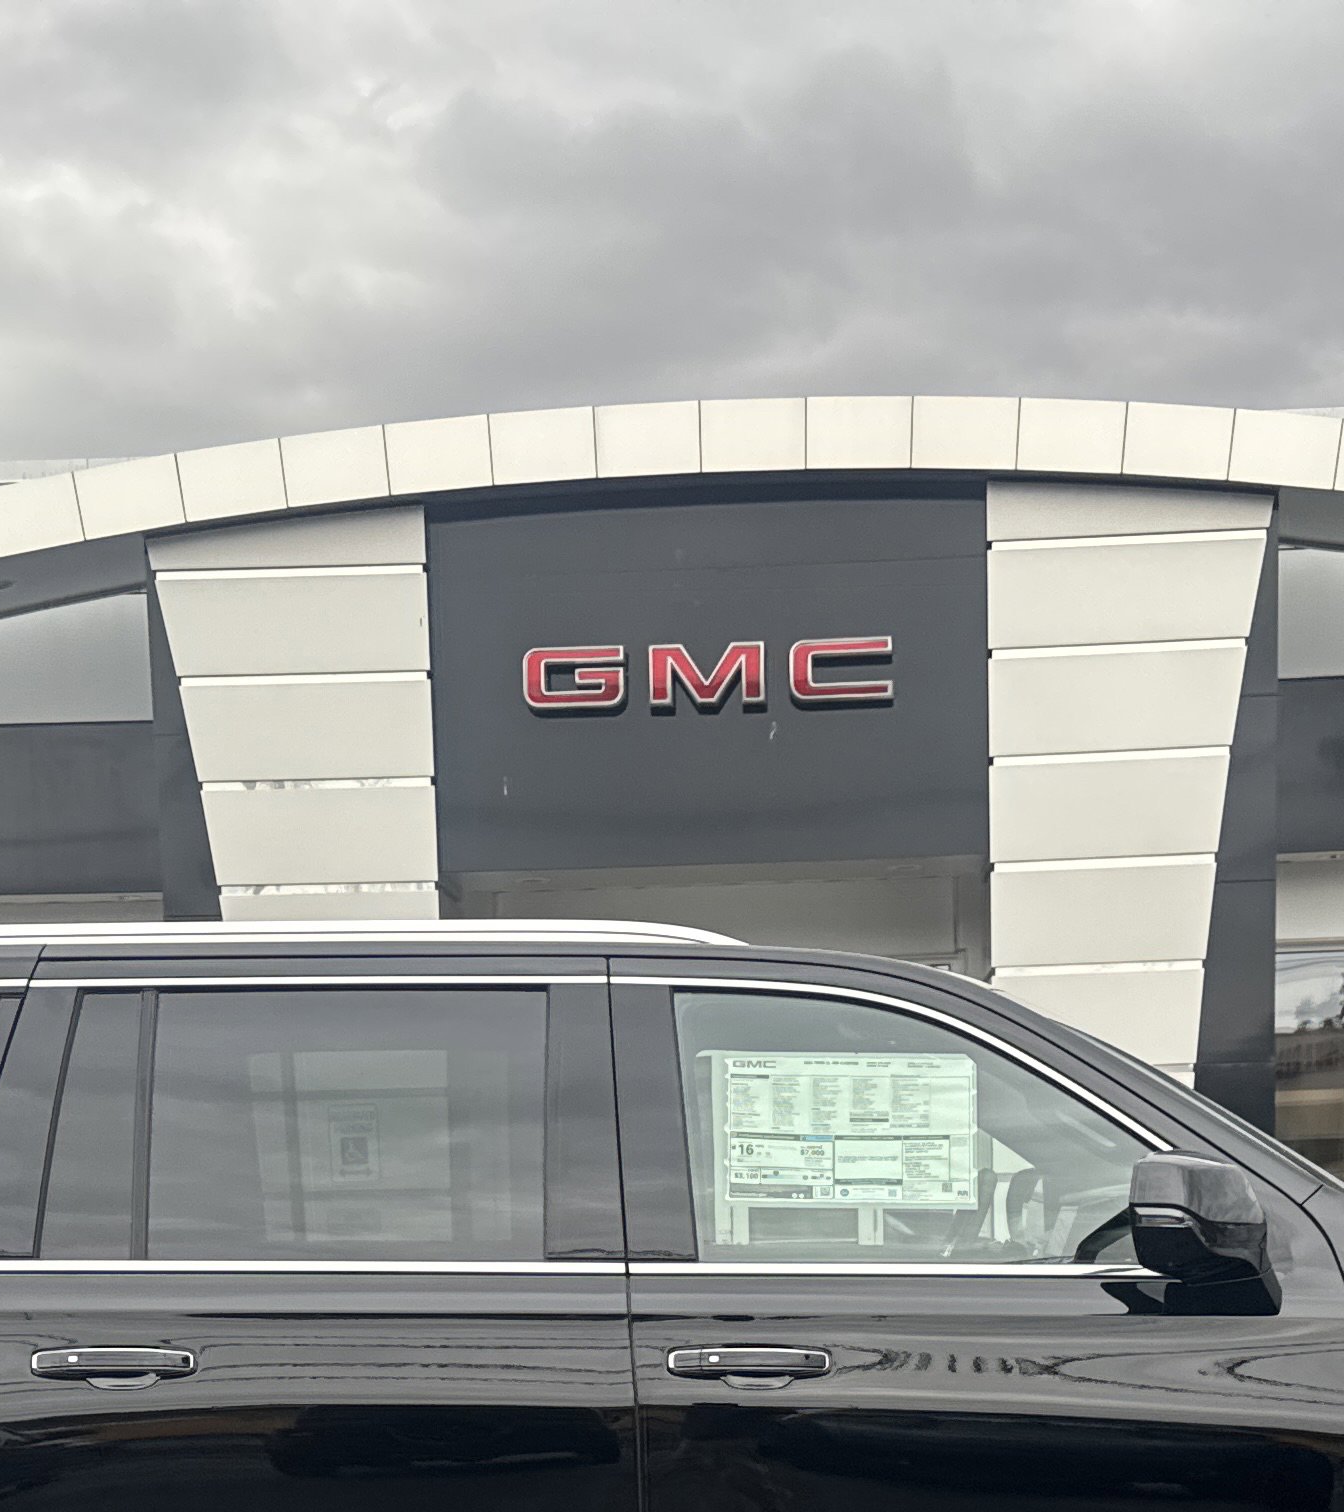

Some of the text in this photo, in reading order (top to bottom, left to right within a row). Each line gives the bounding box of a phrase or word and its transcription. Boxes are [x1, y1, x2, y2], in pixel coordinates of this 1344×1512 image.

[523, 636, 894, 713] GMC
[732, 1060, 777, 1069] GMC
[738, 1144, 754, 1156] 16
